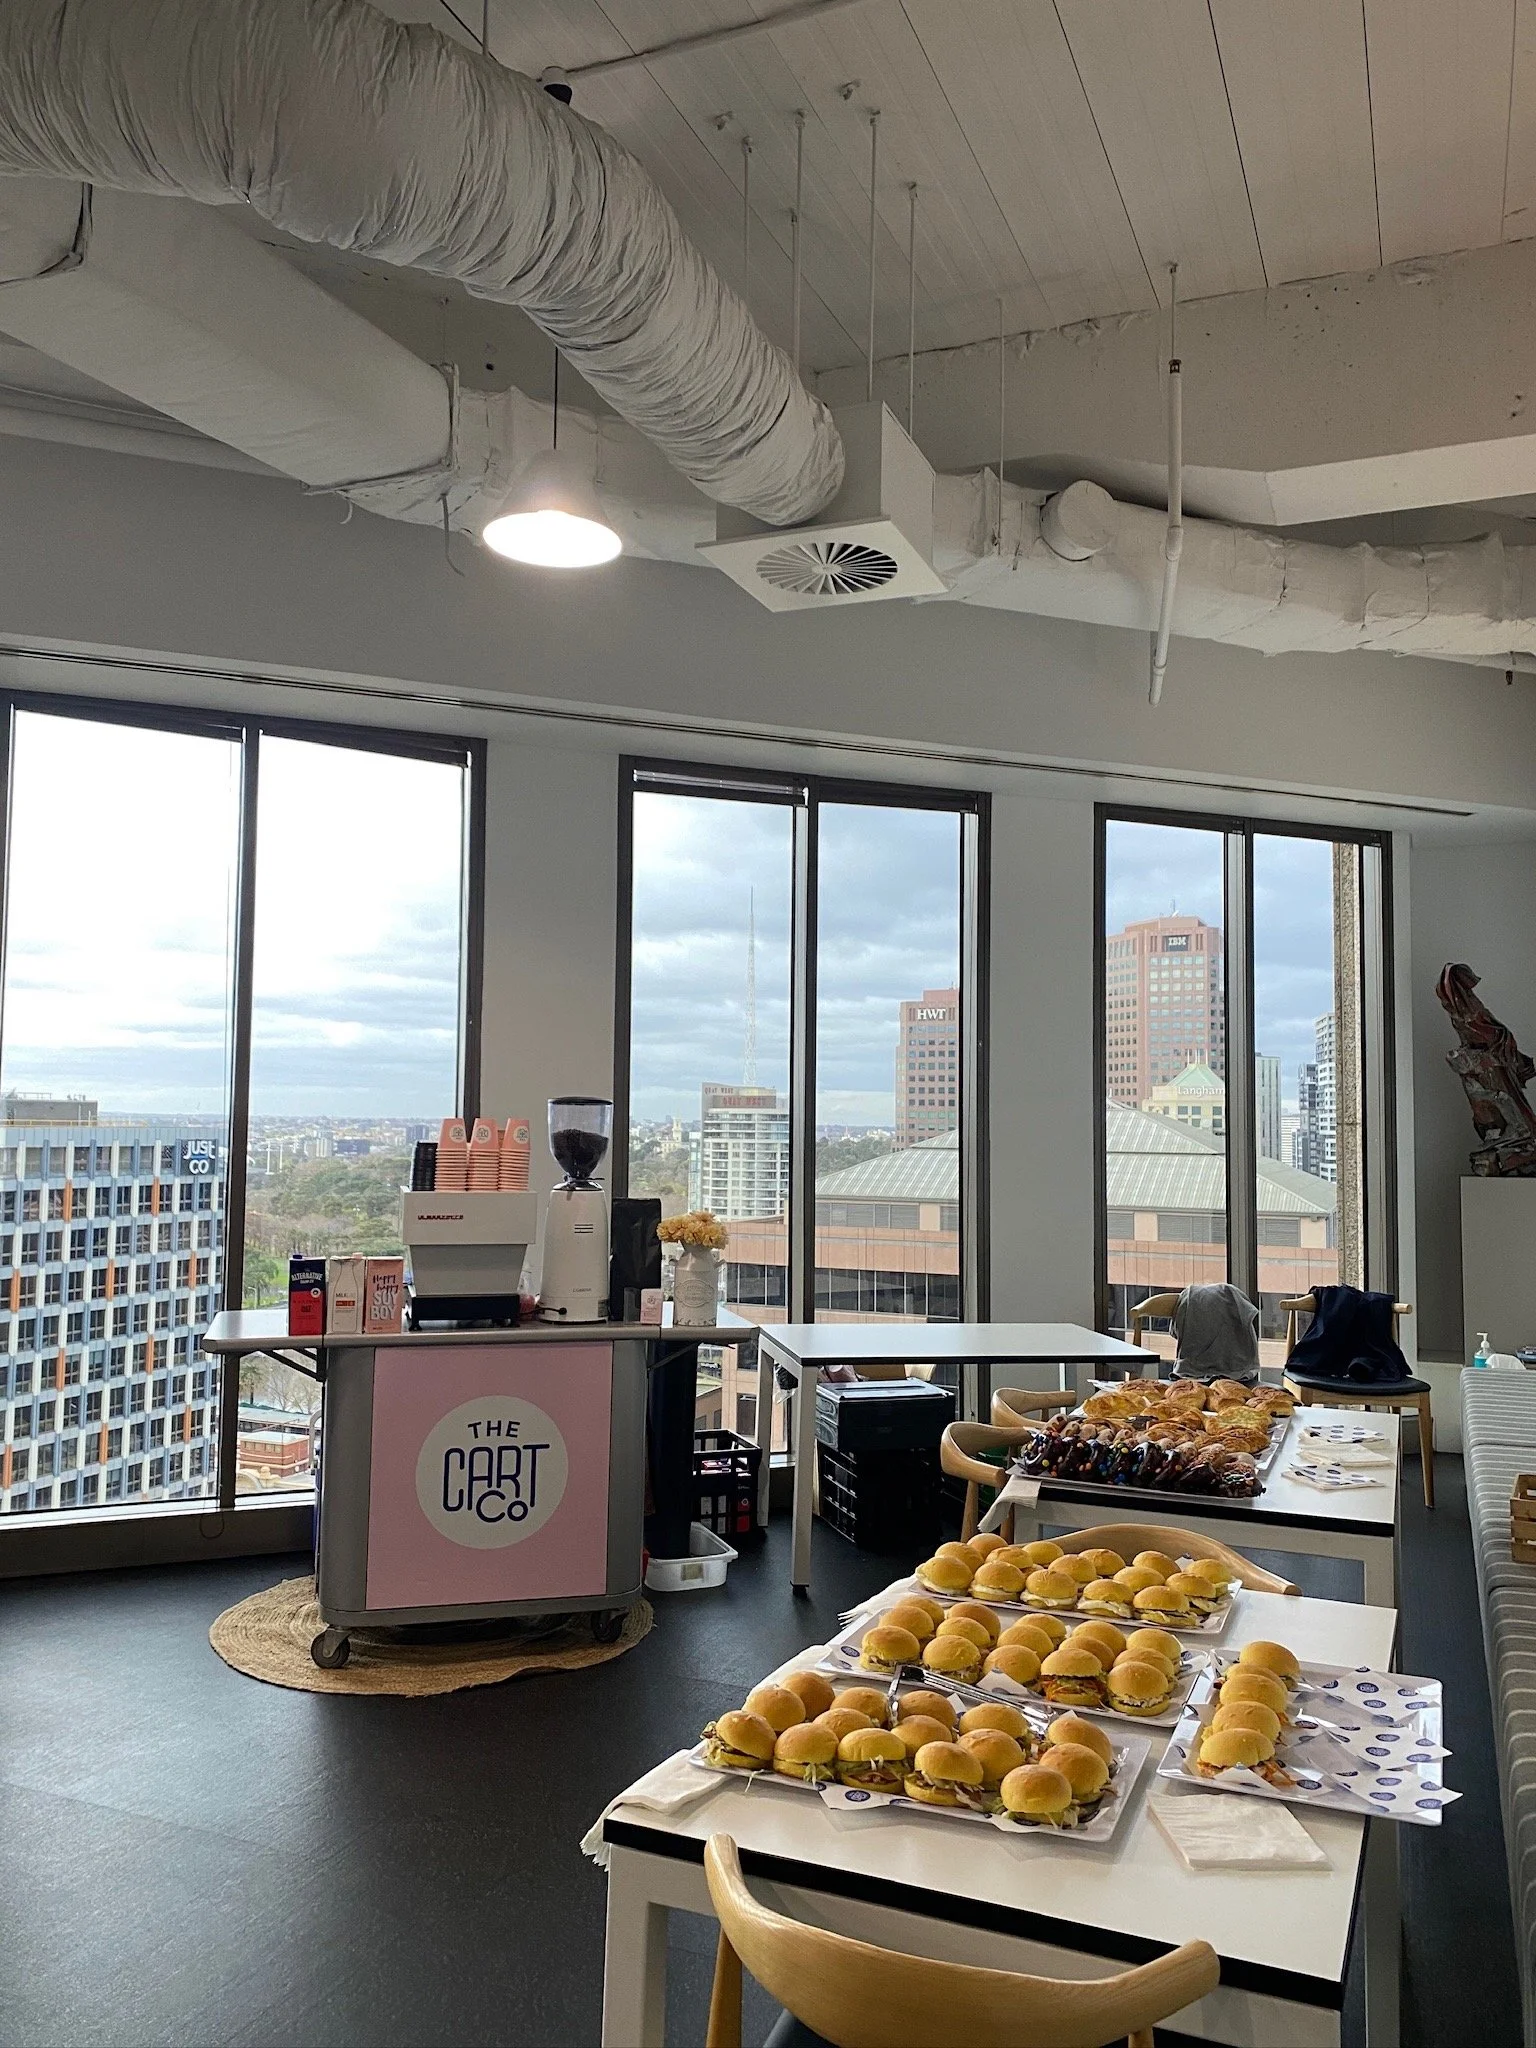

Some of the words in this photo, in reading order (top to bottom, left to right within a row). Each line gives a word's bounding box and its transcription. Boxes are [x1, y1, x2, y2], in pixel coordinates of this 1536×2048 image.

[1168, 936, 1187, 946] IBM
[917, 1008, 947, 1020] HWT
[1178, 1085, 1225, 1098] Langham
[371, 1305, 396, 1320] BOY
[467, 1420, 521, 1439] THE
[442, 1443, 550, 1512] CART
